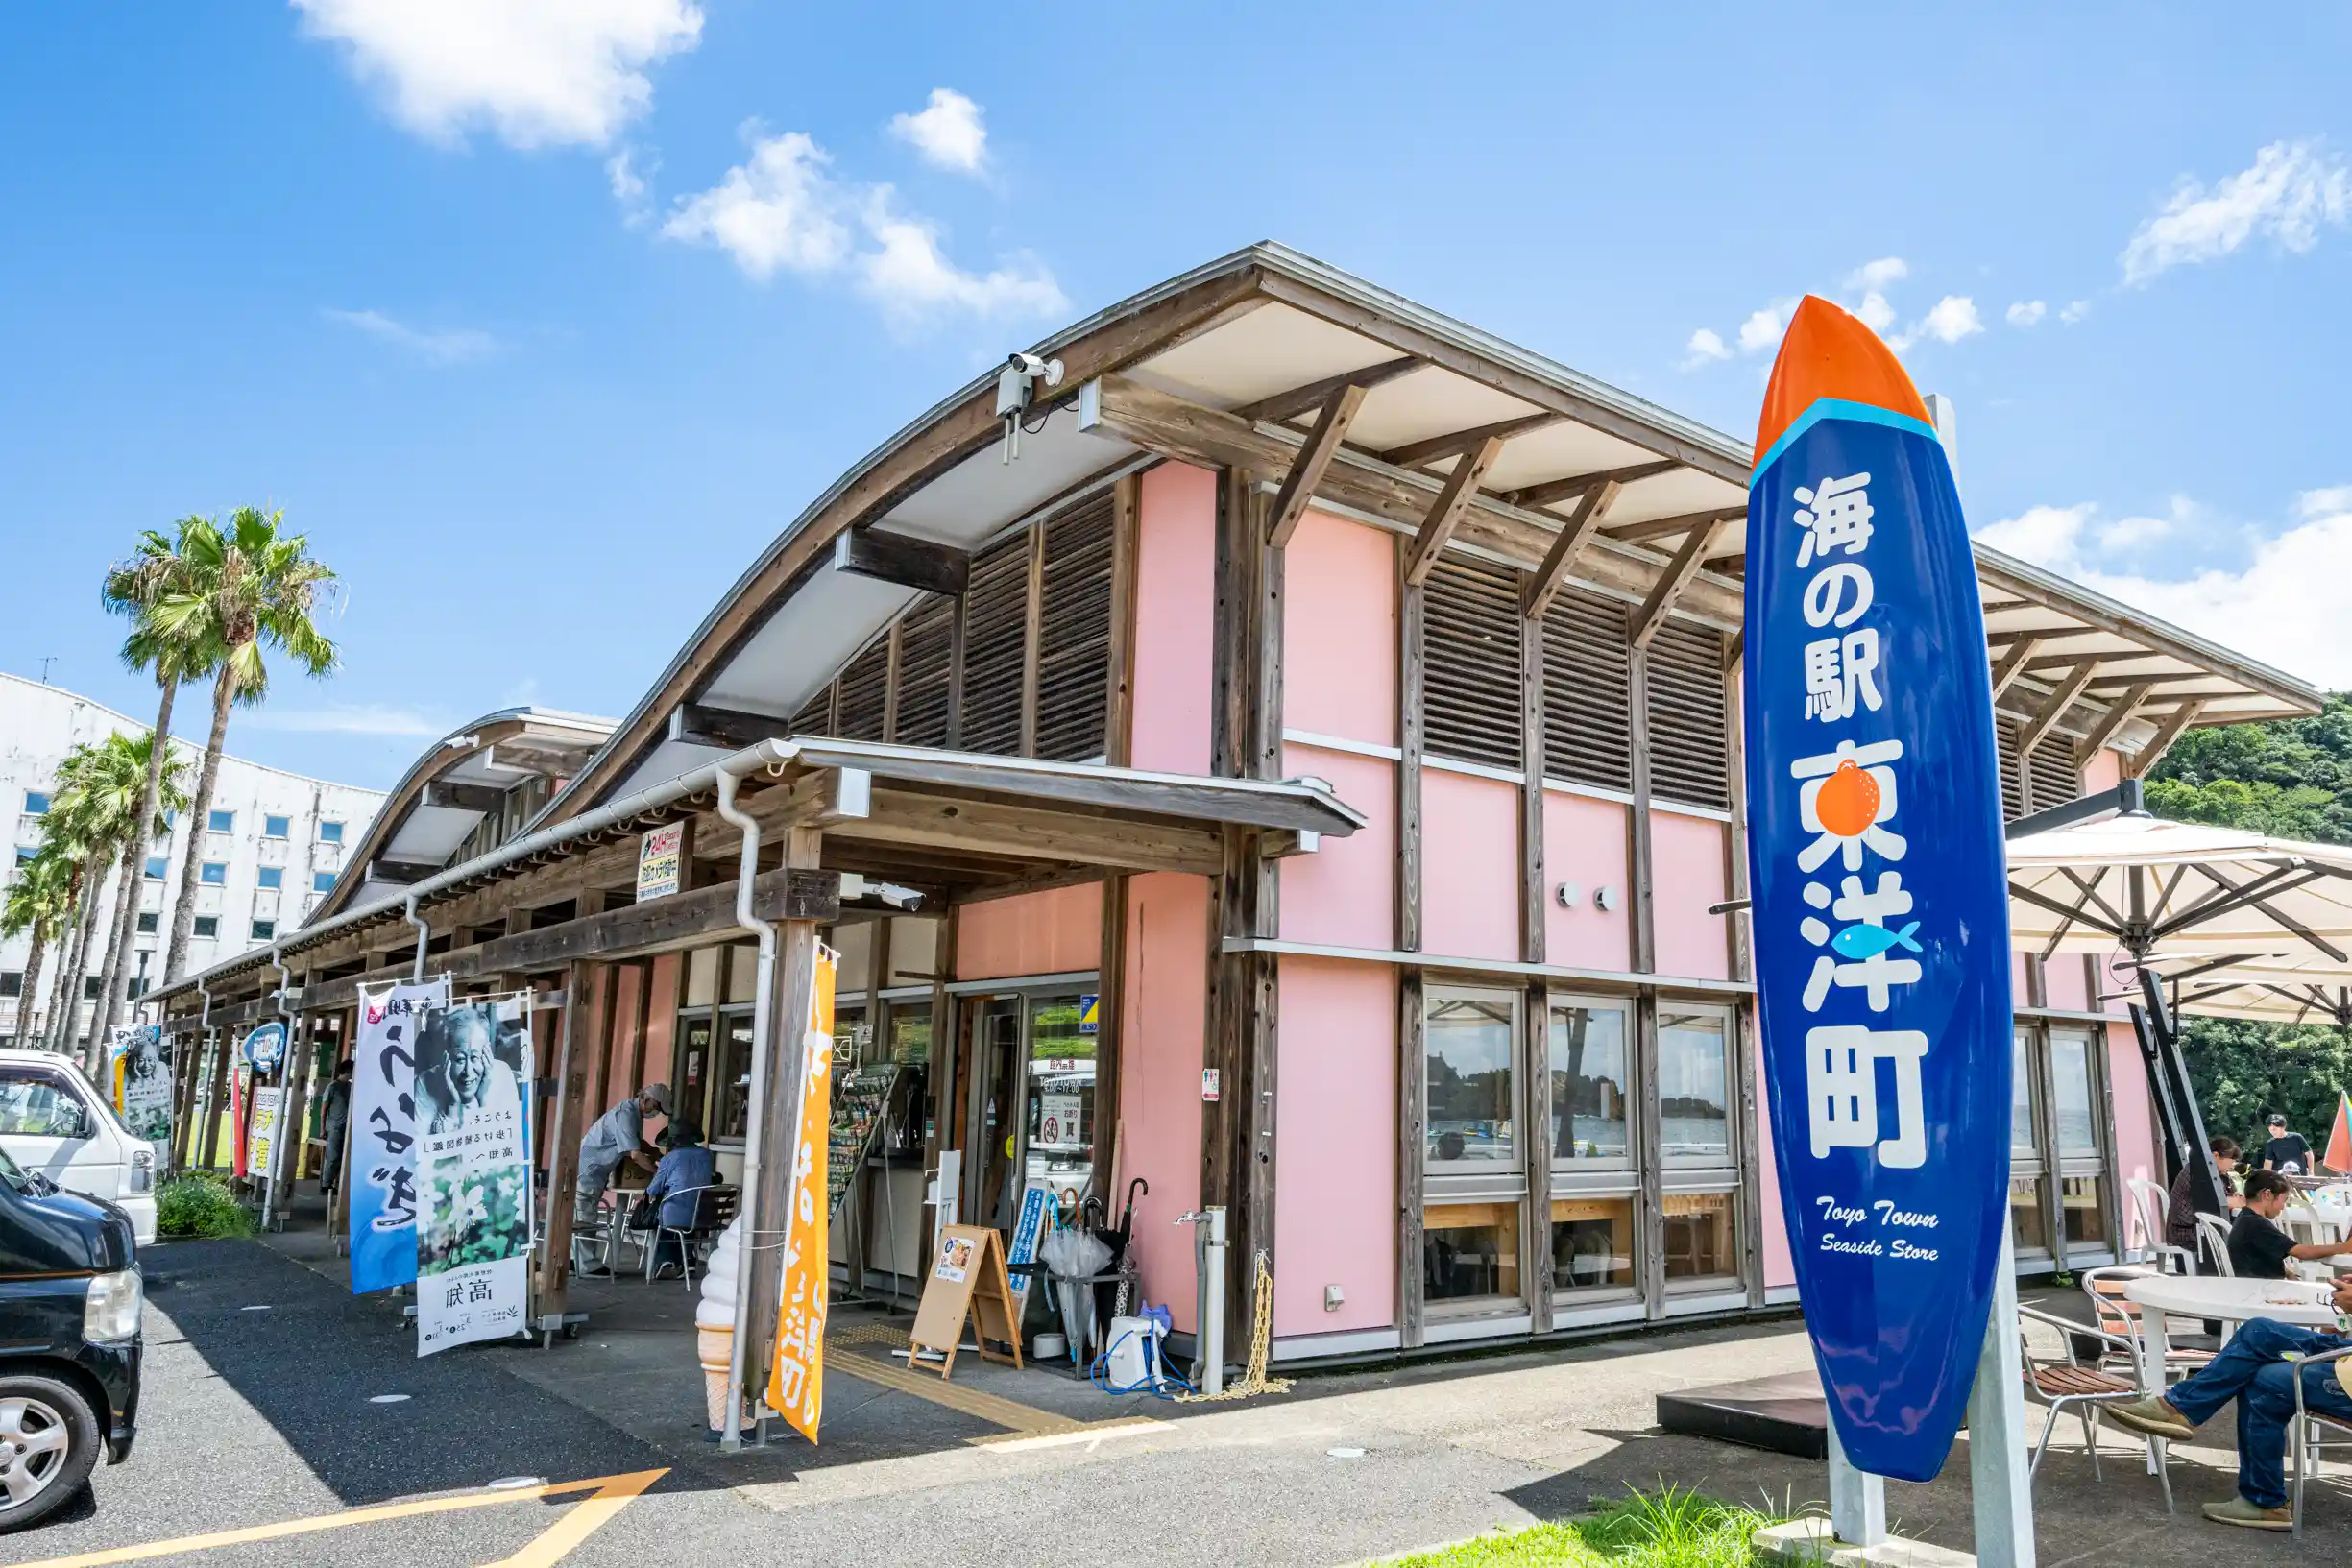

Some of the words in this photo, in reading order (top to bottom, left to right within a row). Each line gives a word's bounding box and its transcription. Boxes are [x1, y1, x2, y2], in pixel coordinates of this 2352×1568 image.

[1793, 472, 1882, 723] 海の駅
[1790, 739, 1928, 1169] 東洋町
[1816, 1195, 1867, 1228] Toyo
[1874, 1199, 1939, 1228] Town
[1820, 1233, 1883, 1256] Seaside
[1889, 1239, 1939, 1261] Store
